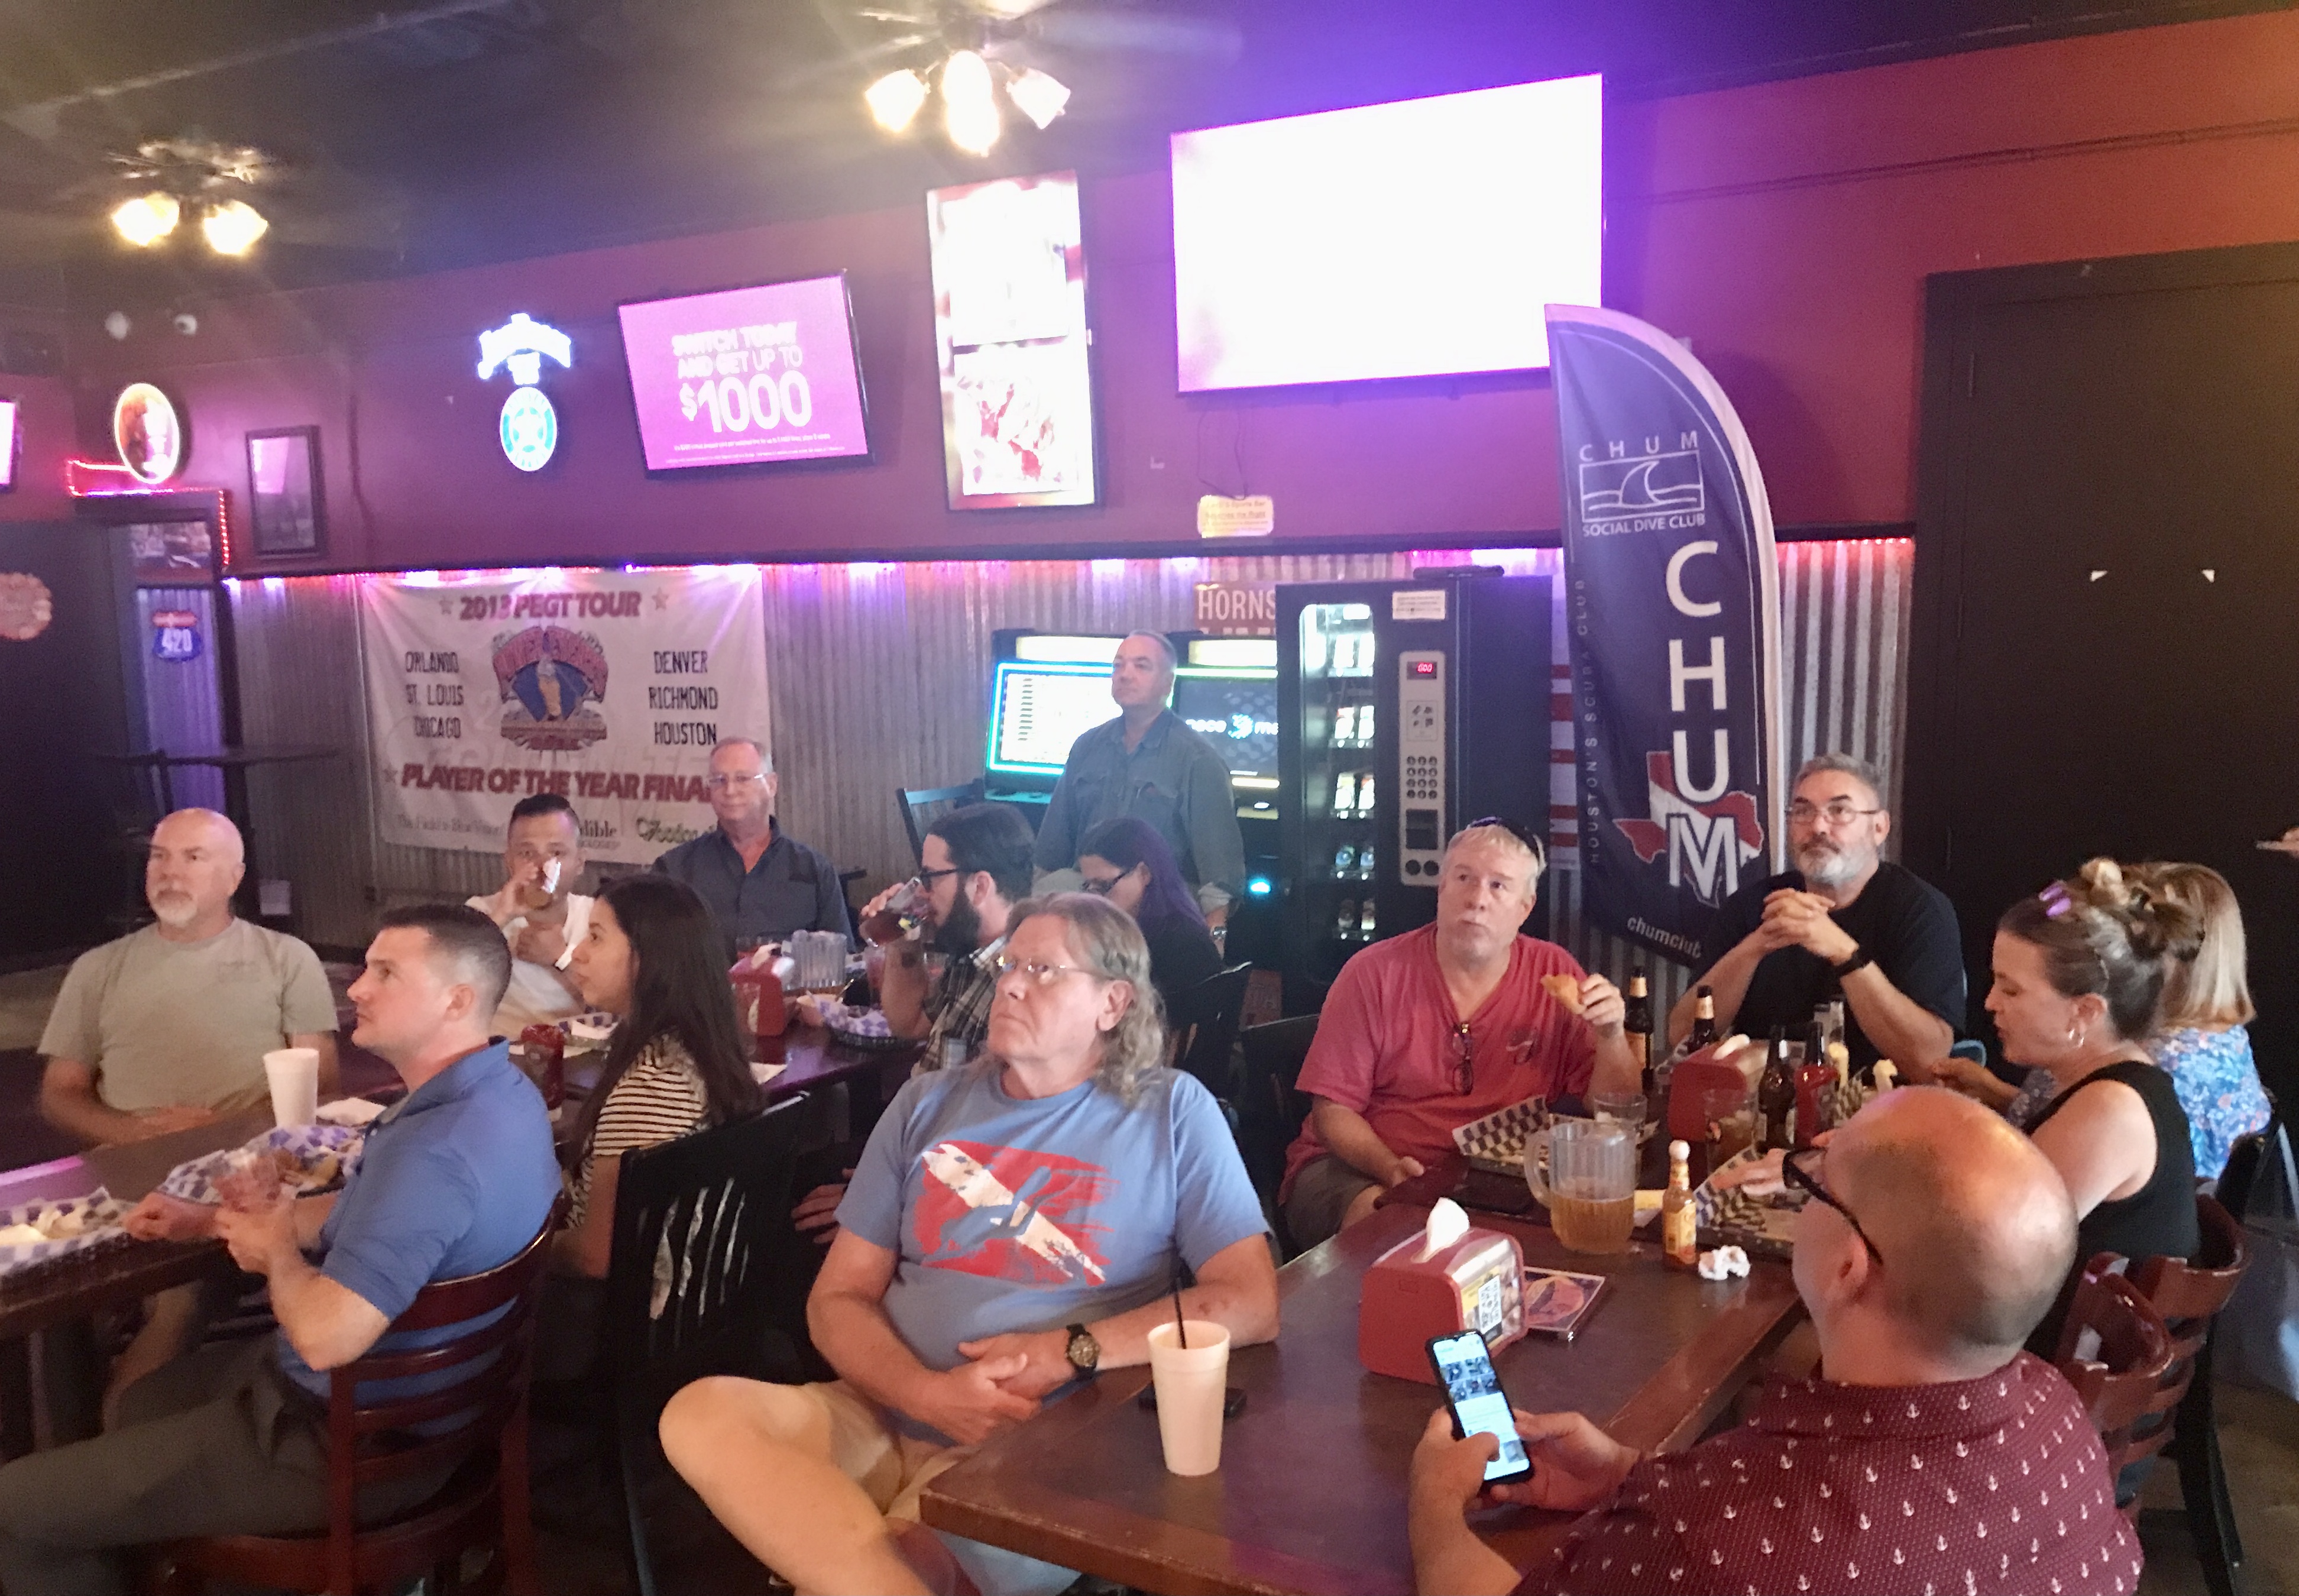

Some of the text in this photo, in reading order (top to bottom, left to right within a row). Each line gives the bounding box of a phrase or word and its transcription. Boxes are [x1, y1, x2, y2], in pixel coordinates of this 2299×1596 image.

[672, 321, 798, 357] SWITCH TODAY
[678, 344, 803, 379] AND GET UP TO
[679, 370, 812, 433] $1000
[1579, 430, 1698, 462] CHUM
[1582, 513, 1705, 537] SOCIAL DIVE CLUB
[513, 591, 572, 619] PEGT
[576, 591, 642, 618] TOUR
[1198, 590, 1276, 620] HORNS
[405, 651, 459, 673] ORLANDO
[653, 650, 708, 674] DENVER
[427, 684, 464, 705] LOUIS
[649, 686, 718, 710] RICHMOND
[413, 716, 461, 739] CHICAGO
[654, 721, 717, 746] HOUSTON
[1575, 580, 1599, 863] HOUSTON'S SCUBA CLUB
[1666, 540, 1739, 899] CHUM
[401, 763, 485, 792] PLAYER
[488, 768, 520, 794] OF
[524, 769, 572, 797] THE
[574, 771, 640, 799] YEAR
